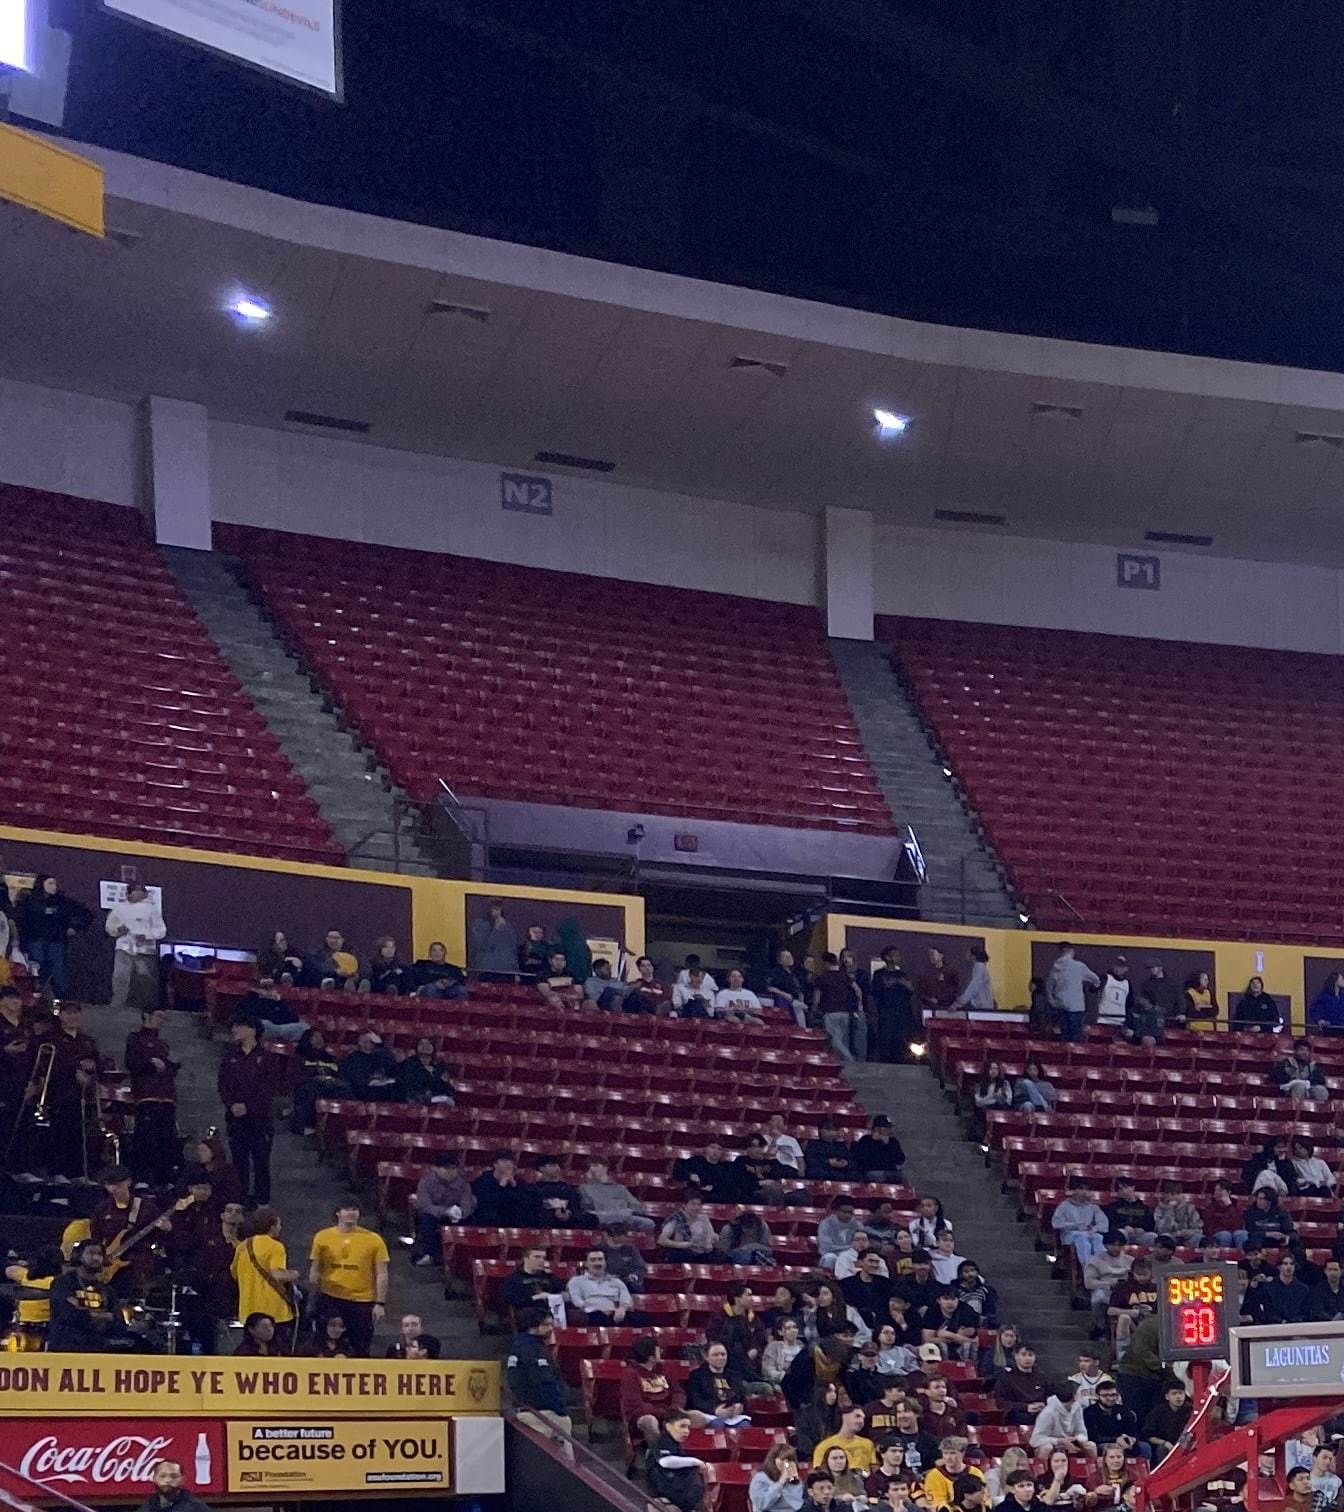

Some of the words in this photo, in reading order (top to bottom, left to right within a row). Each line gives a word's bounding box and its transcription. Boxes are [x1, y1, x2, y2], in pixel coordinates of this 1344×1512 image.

[504, 480, 548, 507] N2
[1124, 560, 1154, 584] P1
[1182, 1307, 1216, 1344] 30
[1264, 1344, 1330, 1367] LAGUNITAS
[58, 1368, 105, 1392] ALL
[115, 1369, 180, 1394] HOPE
[192, 1370, 224, 1394] YE
[235, 1371, 298, 1395] WHO
[308, 1373, 387, 1395] ENTER
[398, 1374, 456, 1395] HERE
[254, 1429, 264, 1438] A
[265, 1428, 299, 1438] better
[299, 1428, 333, 1438] future
[238, 1440, 345, 1461] because
[351, 1438, 377, 1460] of
[383, 1438, 443, 1459] YOU.
[240, 1471, 263, 1482] ASU
